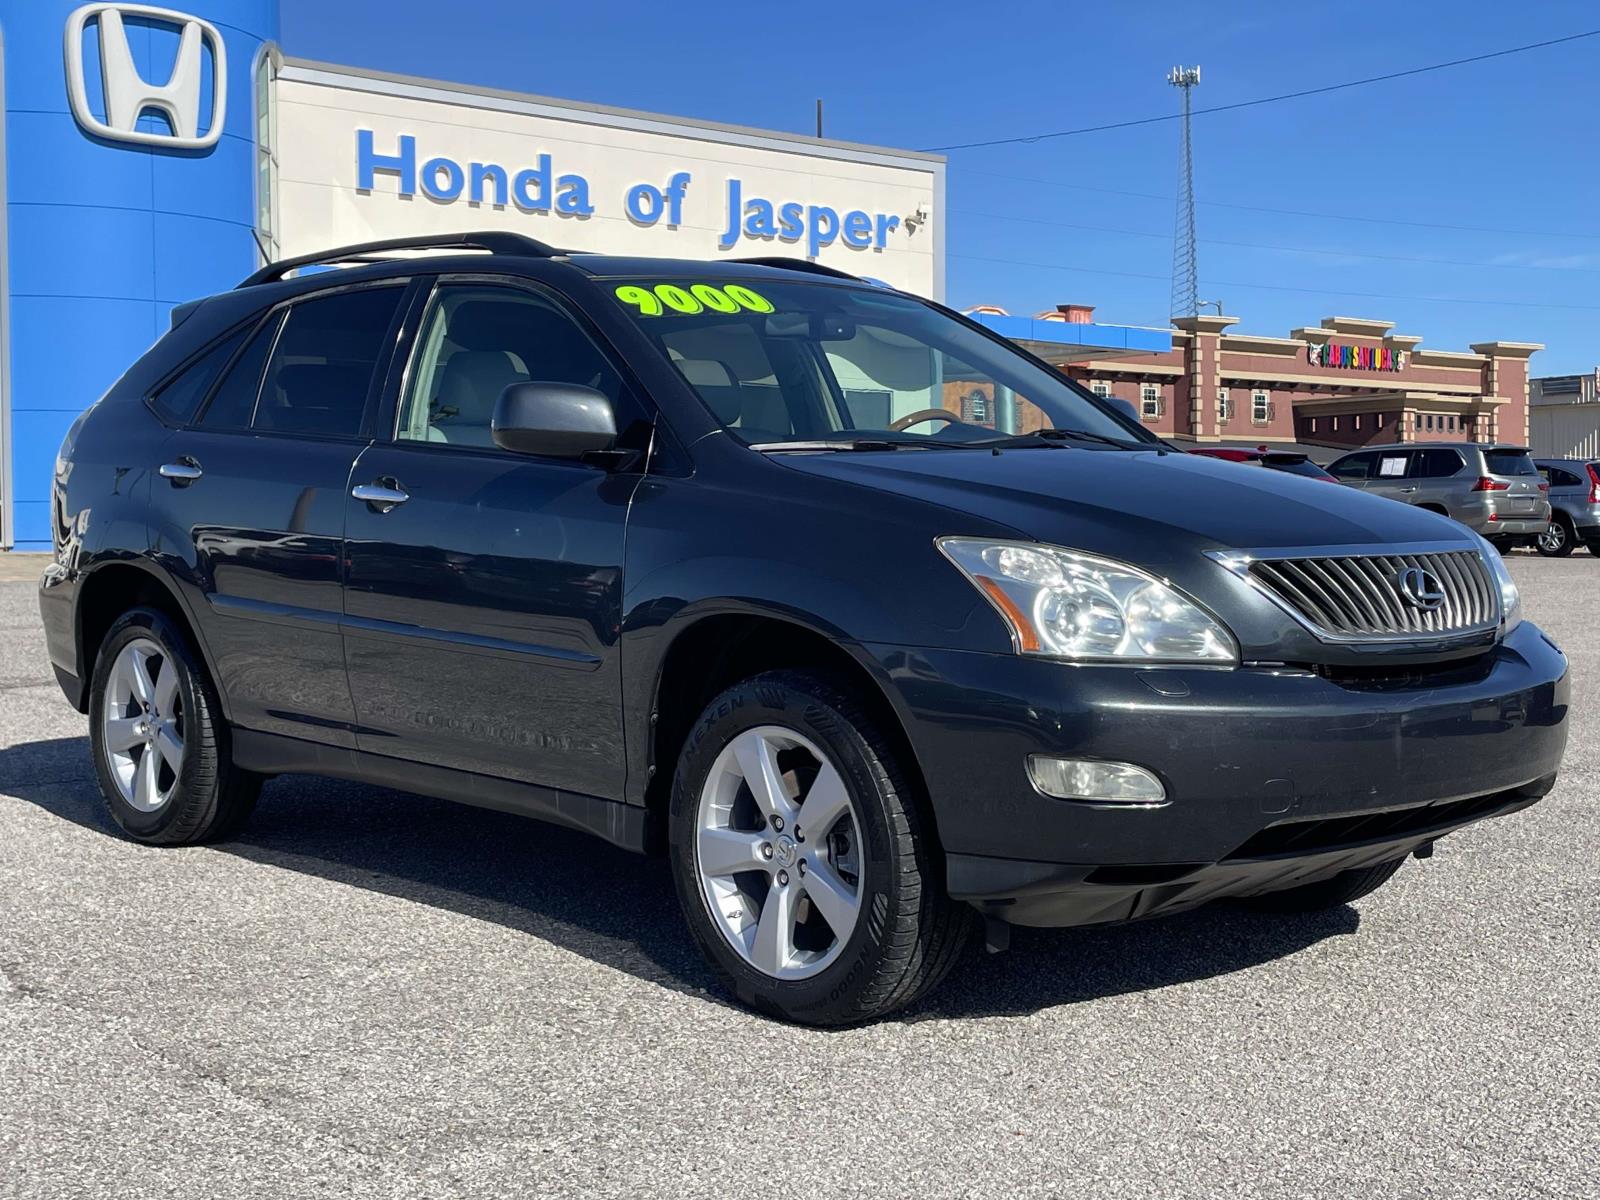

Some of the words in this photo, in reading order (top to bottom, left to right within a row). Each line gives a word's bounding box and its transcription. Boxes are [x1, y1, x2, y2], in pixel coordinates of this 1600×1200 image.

[355, 129, 595, 218] Honda
[624, 172, 691, 226] of
[719, 179, 900, 257] Jasper
[615, 284, 775, 316] 9000
[684, 695, 745, 760] NEXEN
